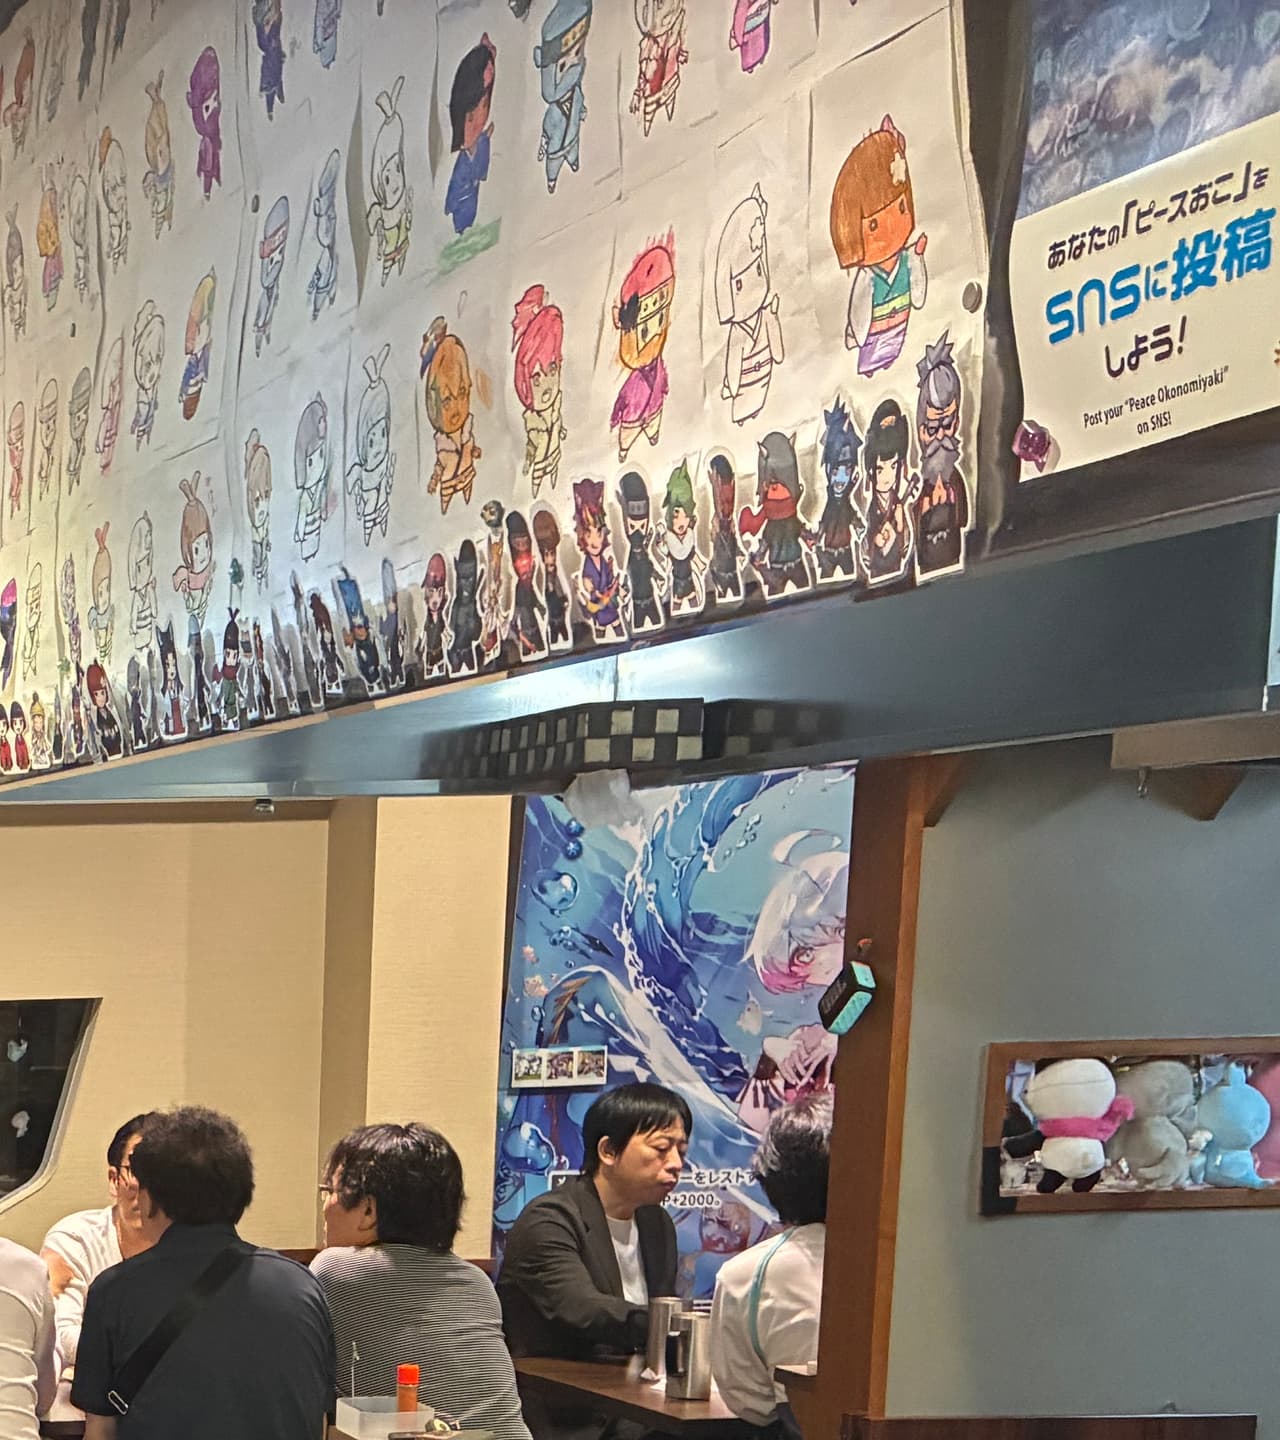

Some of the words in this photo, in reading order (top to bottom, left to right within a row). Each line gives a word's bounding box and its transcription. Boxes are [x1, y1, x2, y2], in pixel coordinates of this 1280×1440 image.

[1047, 161, 1270, 270] あなたの「ピースおこ」を
[1083, 409, 1103, 428] Post
[1103, 404, 1124, 421] your
[1136, 421, 1150, 435] on
[1150, 411, 1173, 432] SNS!
